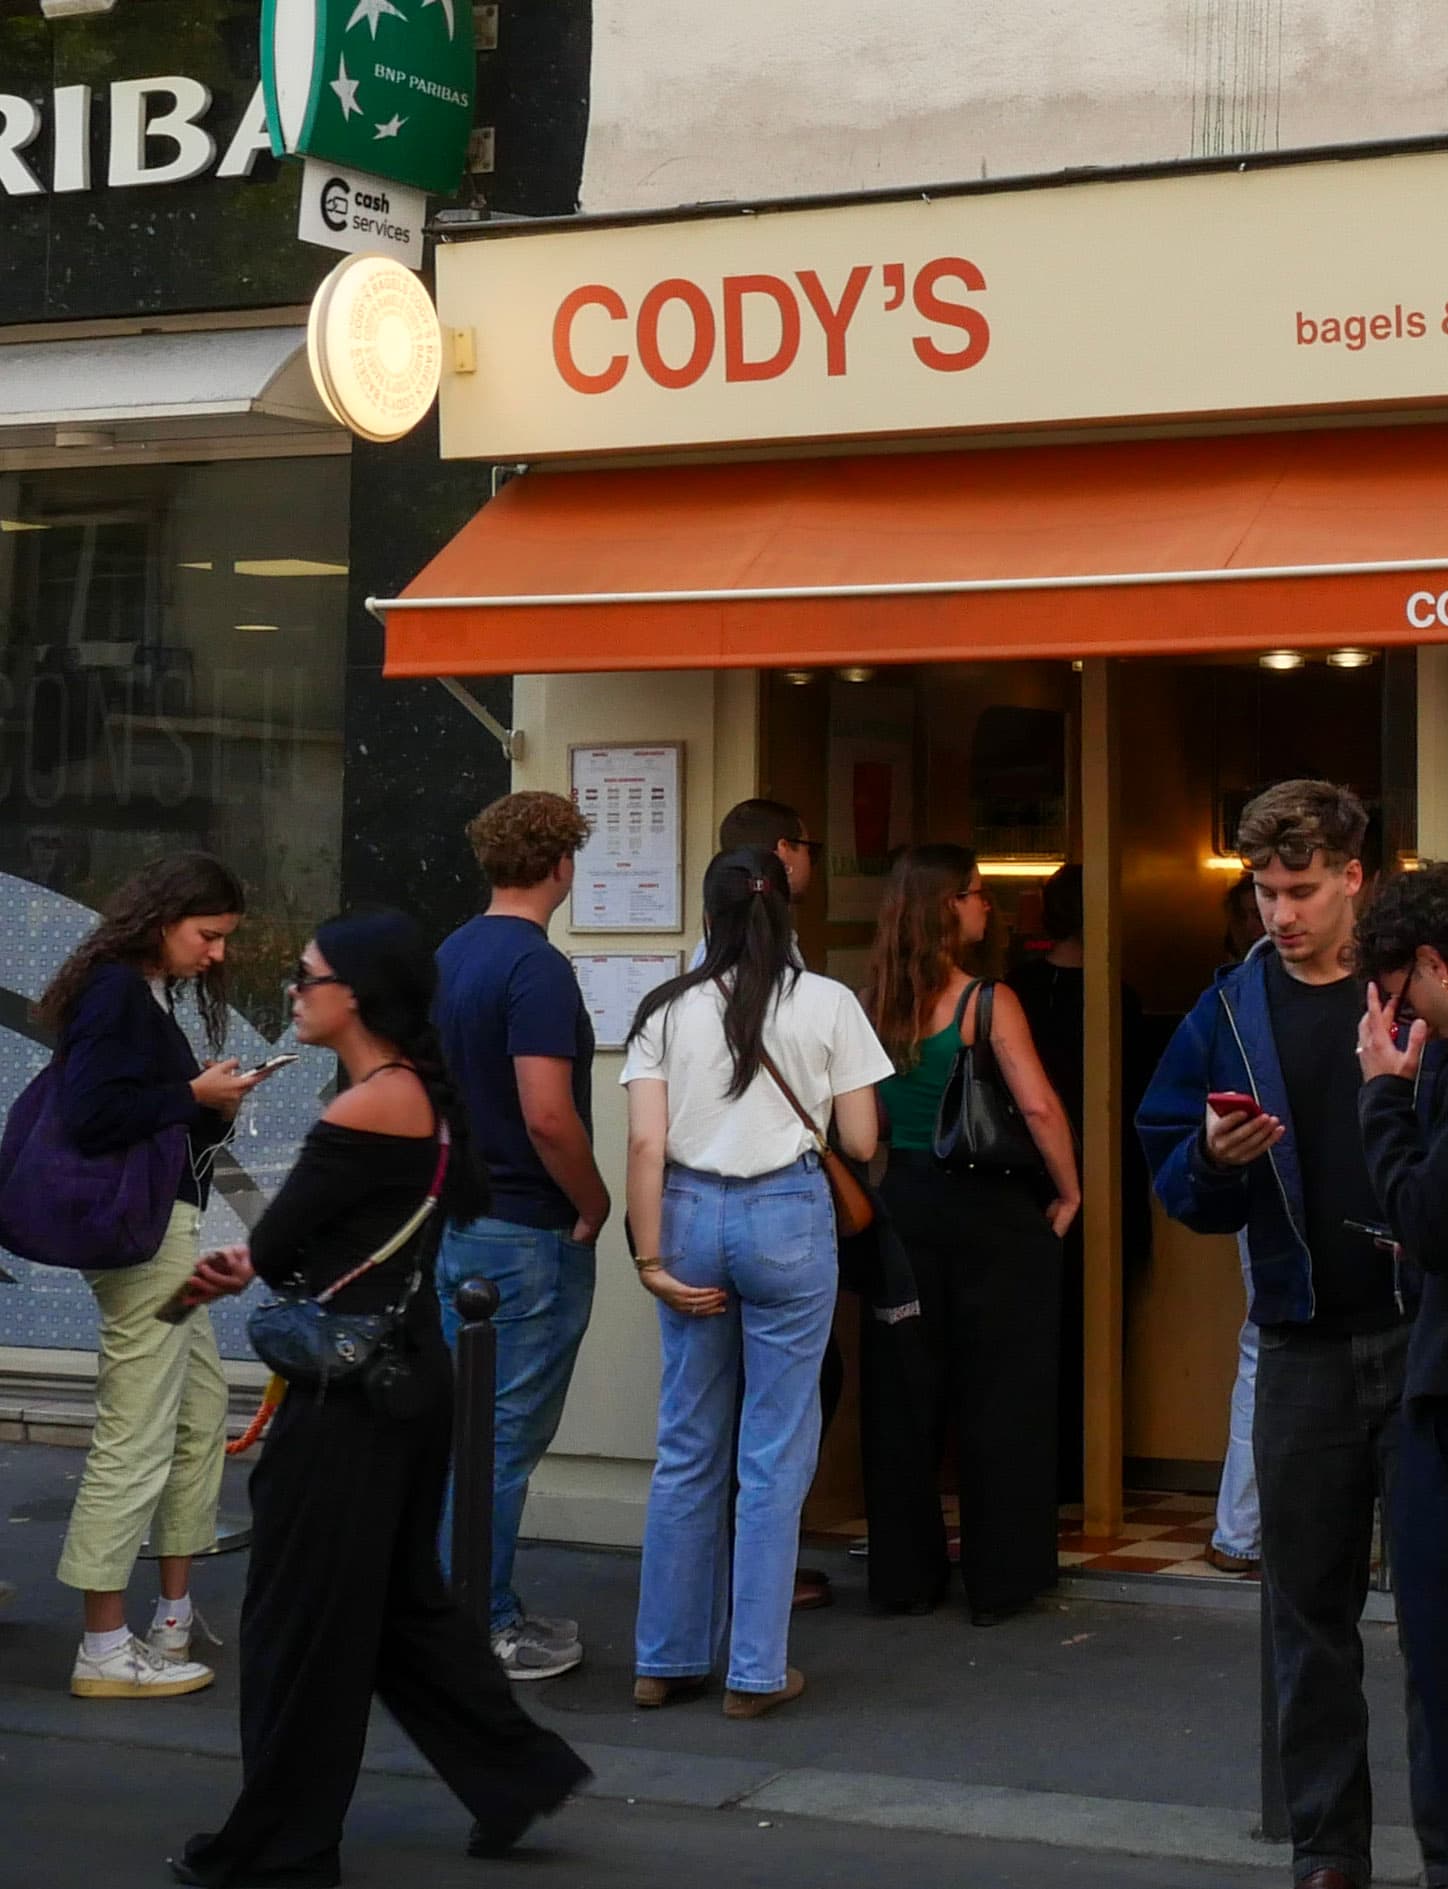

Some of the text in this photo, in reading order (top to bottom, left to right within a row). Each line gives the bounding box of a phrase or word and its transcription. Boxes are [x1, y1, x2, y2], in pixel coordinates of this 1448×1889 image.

[374, 63, 469, 107] BNP PARIBAS
[355, 191, 390, 214] cash
[352, 215, 410, 243] services
[552, 256, 990, 395] CODY'S
[1296, 304, 1426, 351] bagels
